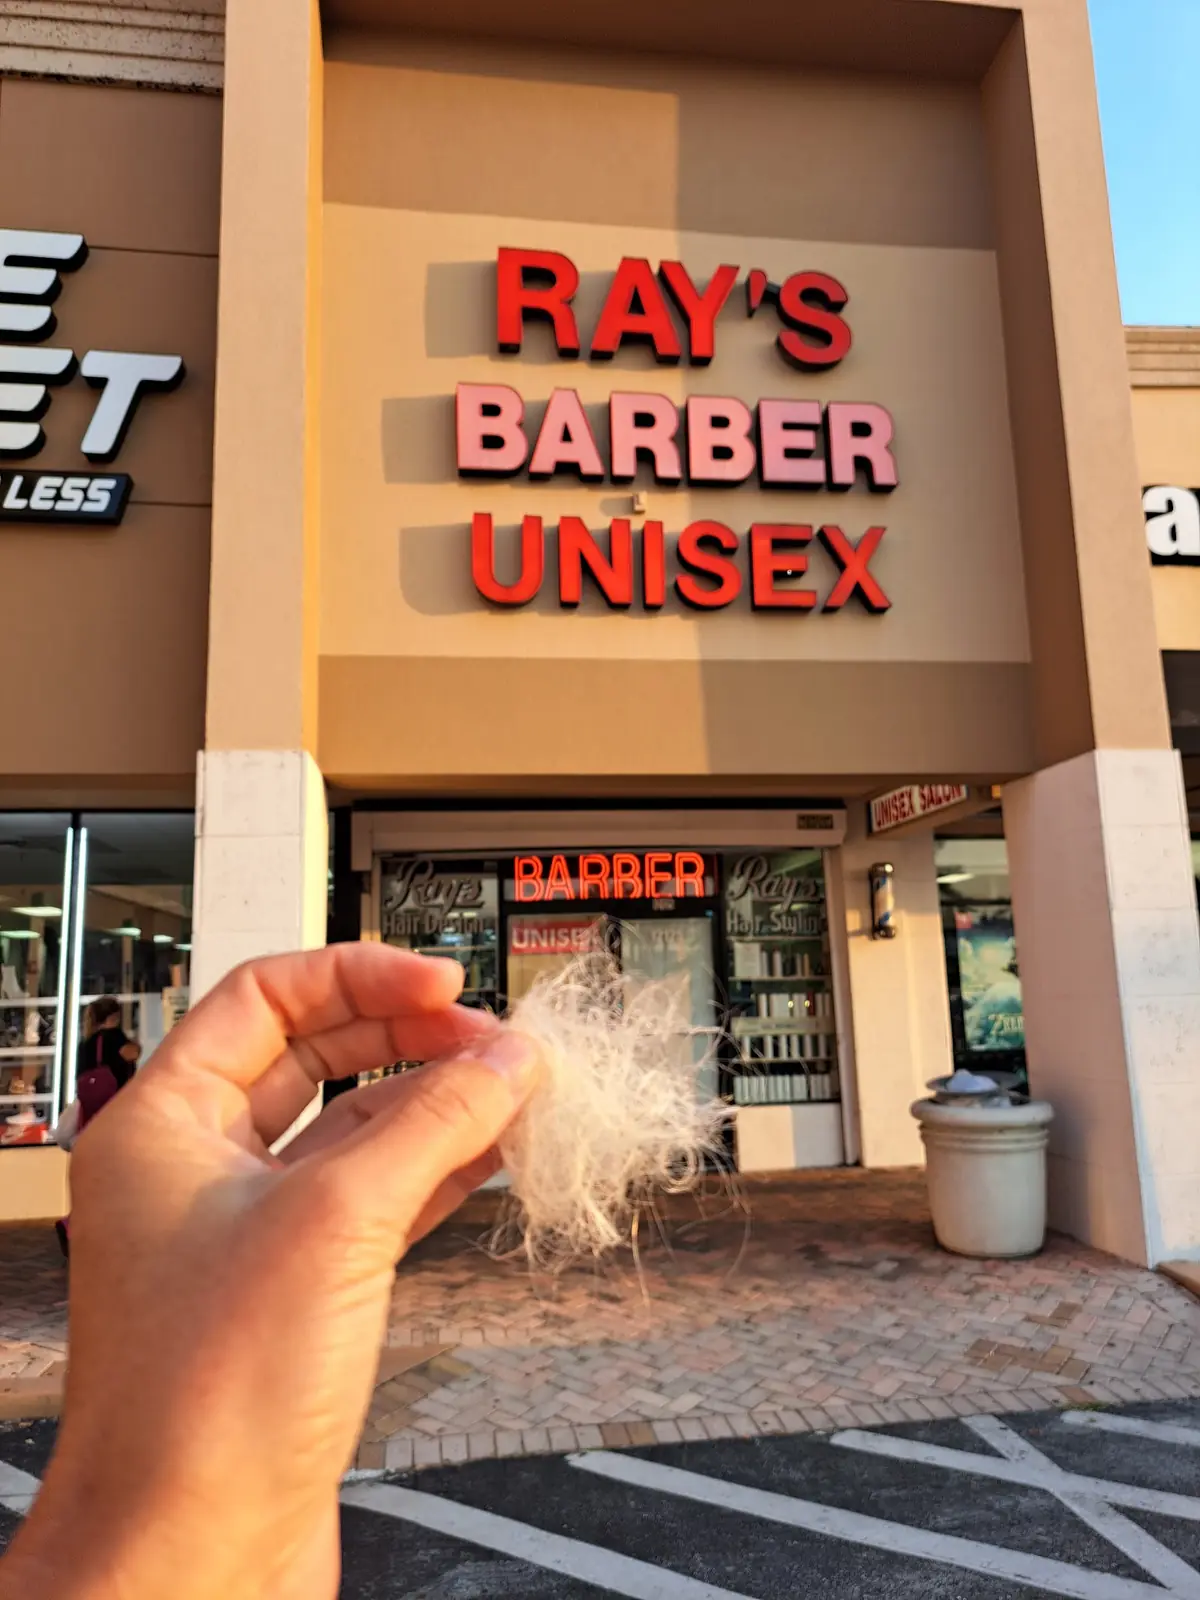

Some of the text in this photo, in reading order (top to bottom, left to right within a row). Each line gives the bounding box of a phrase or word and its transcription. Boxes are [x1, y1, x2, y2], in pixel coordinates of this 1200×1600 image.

[496, 246, 852, 370] RAY'S
[456, 382, 899, 491] BARBER
[2, 474, 117, 512] LESS
[471, 512, 892, 613] UNISEX
[874, 784, 962, 827] UNISEX SALON
[513, 852, 705, 902] BARBER
[383, 911, 419, 935] Hair
[725, 908, 762, 935] Hair
